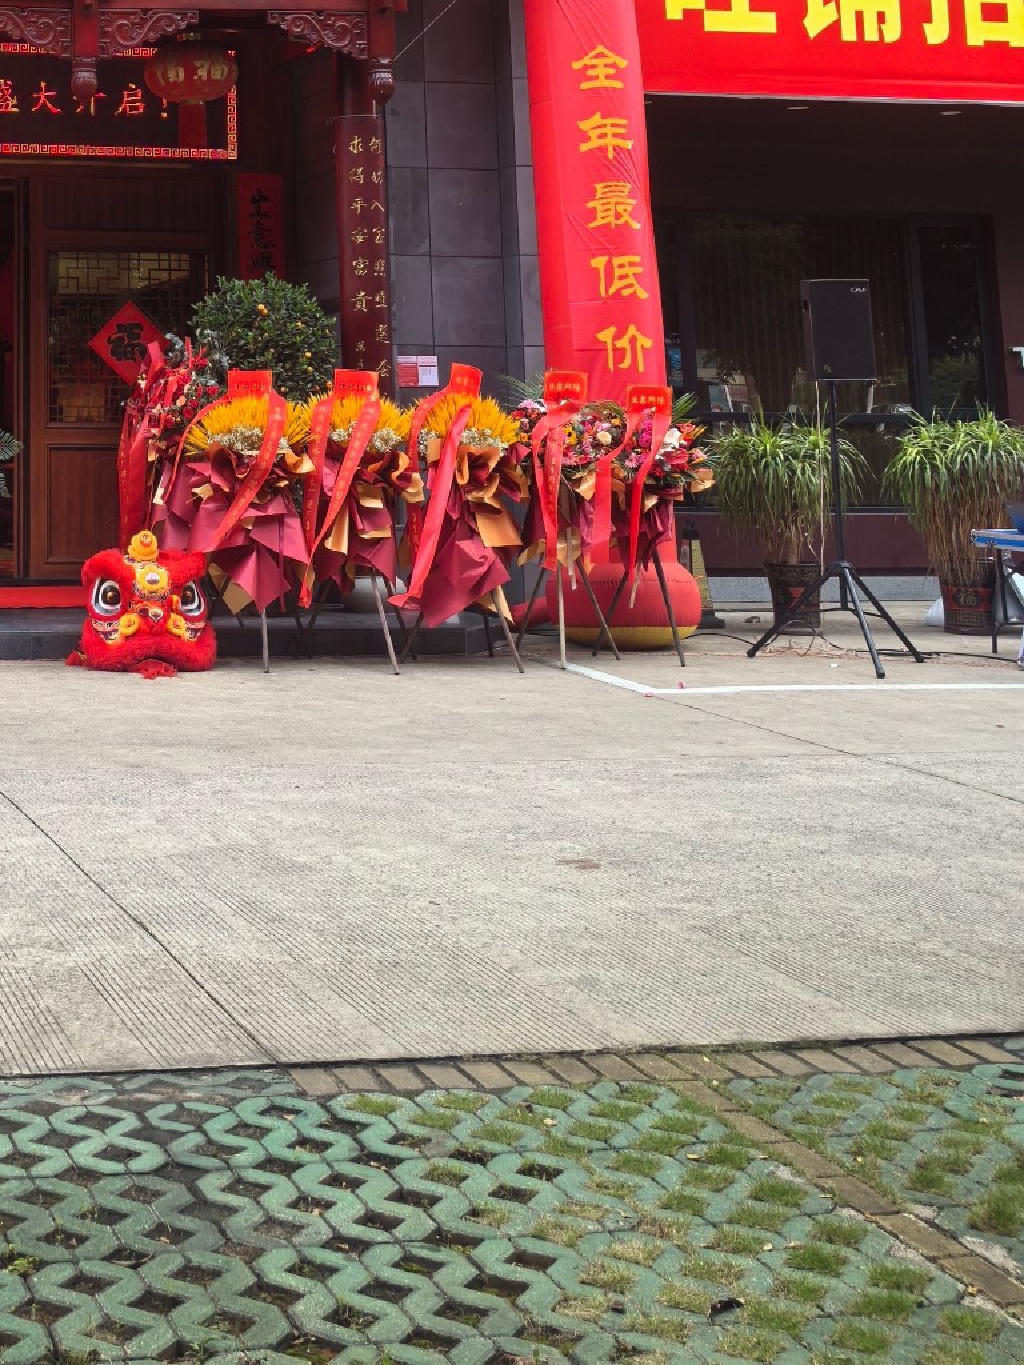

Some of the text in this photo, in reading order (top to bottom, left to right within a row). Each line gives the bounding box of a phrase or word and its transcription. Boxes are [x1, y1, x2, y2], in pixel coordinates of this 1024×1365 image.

[572, 44, 653, 373] 全年最低价
